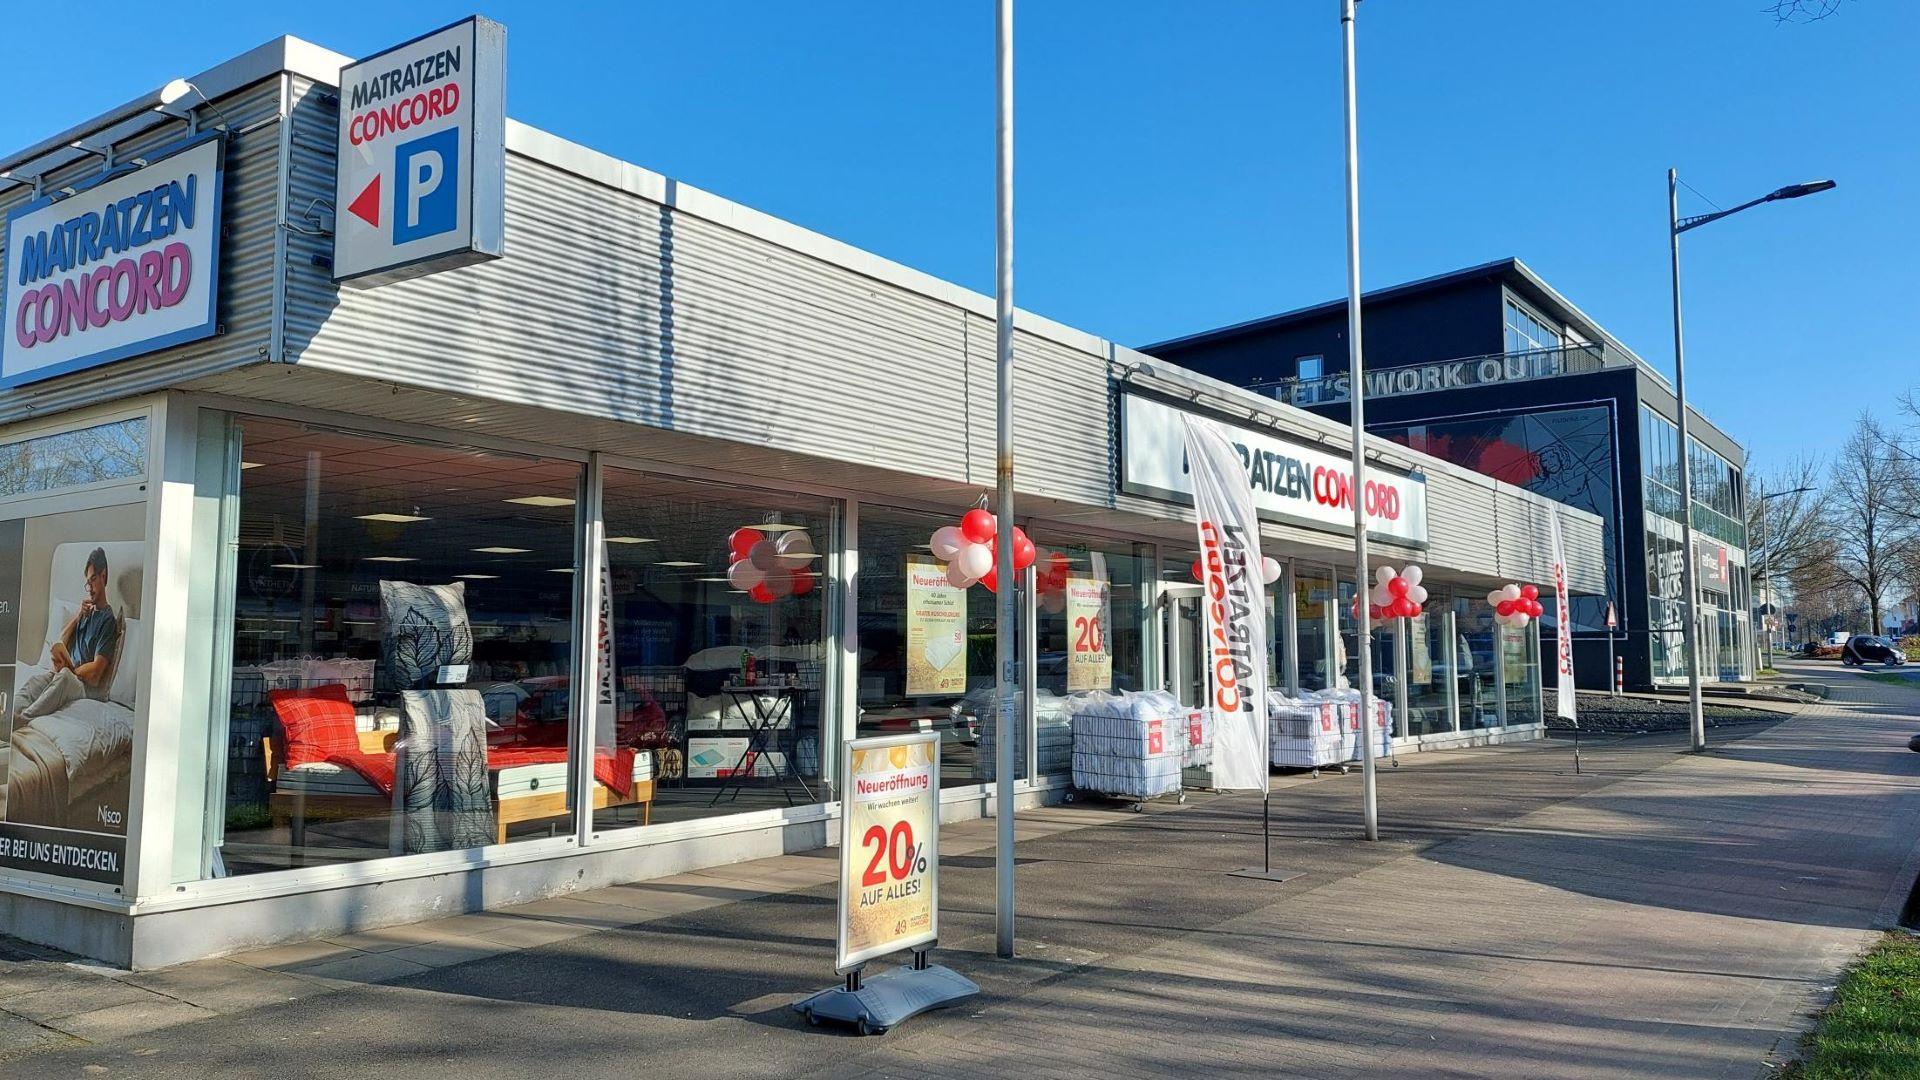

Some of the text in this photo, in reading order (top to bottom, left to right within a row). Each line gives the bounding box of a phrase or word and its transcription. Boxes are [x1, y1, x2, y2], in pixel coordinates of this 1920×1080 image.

[350, 45, 461, 111] MATRATZEN
[349, 82, 460, 146] CONCORD
[407, 149, 444, 228] P
[18, 173, 197, 287] MATRATZEN
[15, 241, 193, 349] CONCORD
[1366, 362, 1464, 397] WORK
[1183, 436, 1400, 520] ATZEN CONORD
[97, 804, 121, 827] Nisco
[857, 773, 928, 794] Neueröffnung
[867, 802, 878, 811] Wir
[13, 839, 28, 859] BEI
[29, 841, 50, 862] UNS
[52, 844, 120, 872] ENTDECKEN.
[862, 820, 927, 887] 20%
[860, 879, 921, 908] AUF ALLES!
